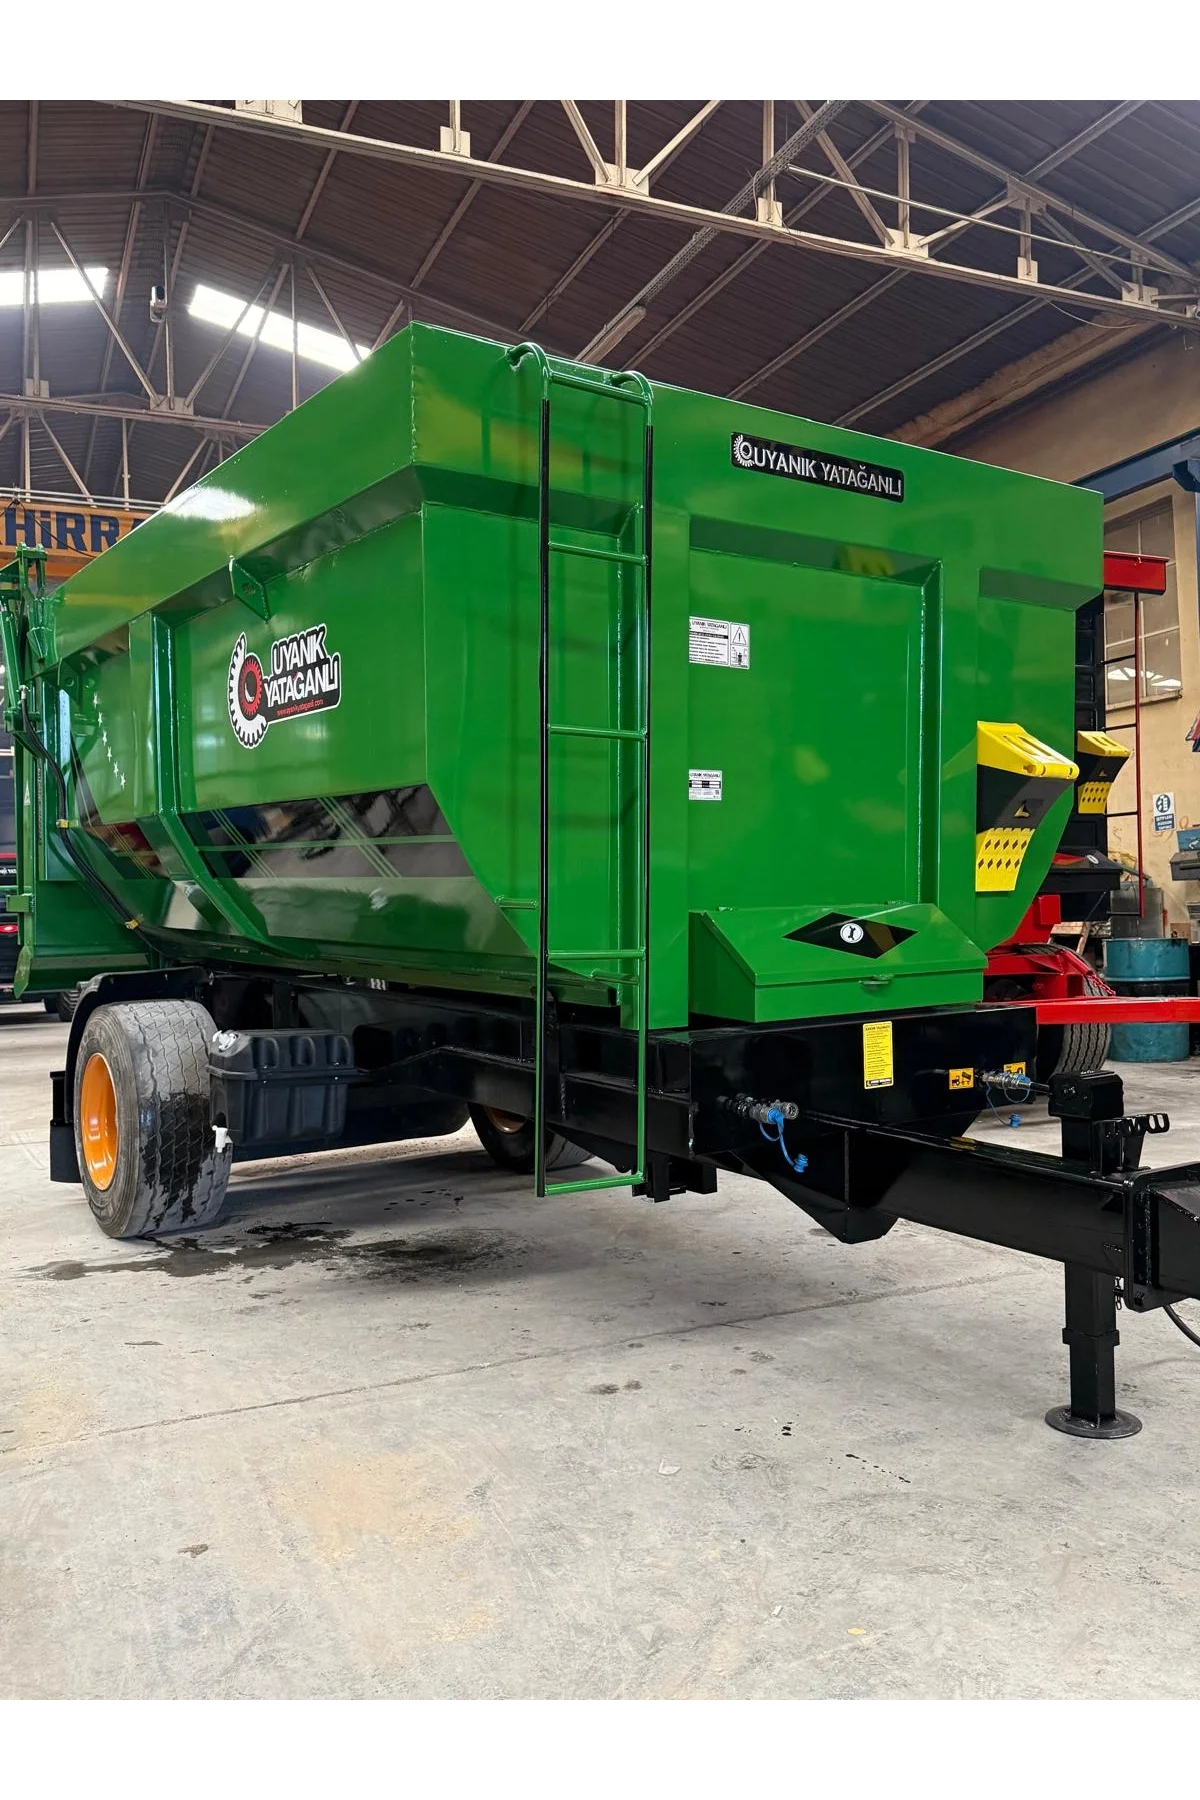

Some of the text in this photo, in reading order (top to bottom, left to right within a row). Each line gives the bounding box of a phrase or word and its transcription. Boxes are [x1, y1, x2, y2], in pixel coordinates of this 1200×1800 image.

[754, 448, 902, 496] UYANIK YATAĞANLI
[273, 631, 325, 675] UYANIK
